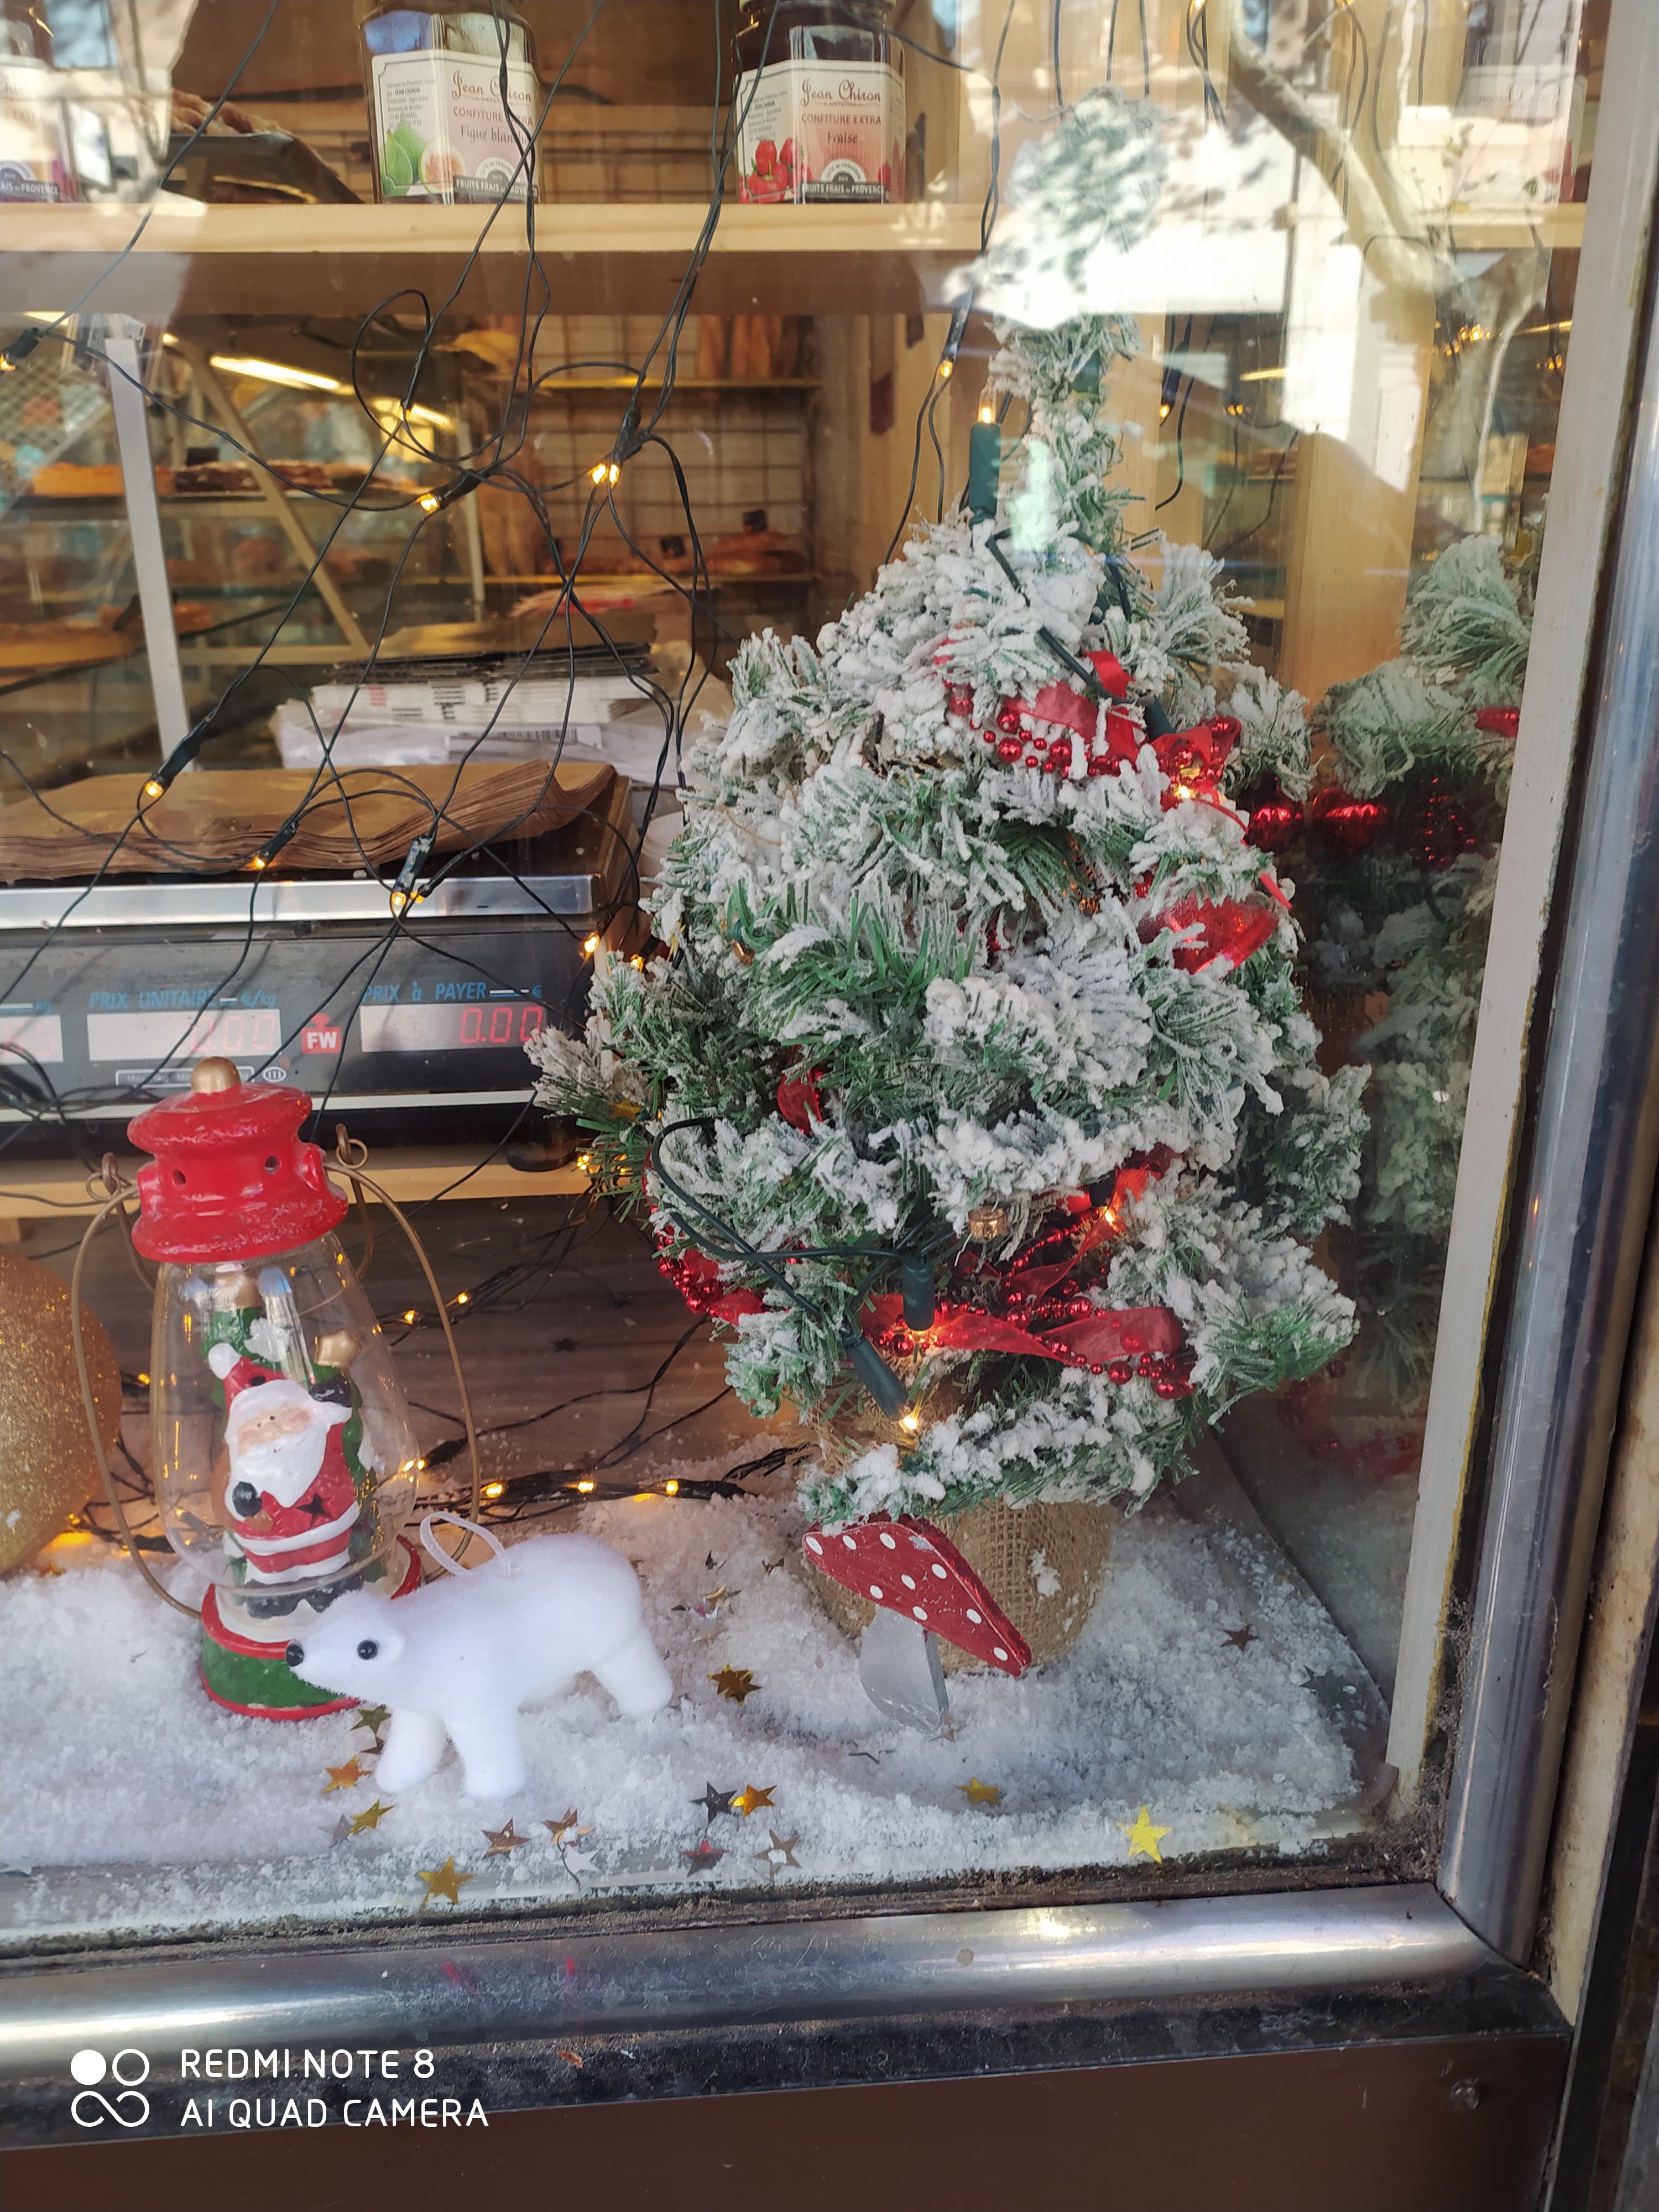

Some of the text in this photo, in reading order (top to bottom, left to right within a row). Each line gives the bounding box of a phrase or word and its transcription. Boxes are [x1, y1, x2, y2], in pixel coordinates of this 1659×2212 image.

[452, 70, 531, 102] Jean Ciron
[801, 79, 832, 106] Jean
[838, 79, 880, 102] Chiron
[453, 107, 503, 122] CONFITURE
[801, 113, 881, 124] CONFITURE EXTRA
[461, 125, 487, 143] Figue
[827, 131, 858, 144] Fraise
[456, 179, 479, 191] FRUITS
[481, 182, 499, 192] FRAIS
[826, 184, 845, 194] FRAIS
[851, 184, 884, 195] PROVENCE
[90, 992, 128, 1010] PRIX
[363, 984, 400, 1002] PRIX
[436, 982, 486, 1000] PAYER
[460, 1005, 543, 1044] 0.00
[307, 1031, 337, 1050] FW
